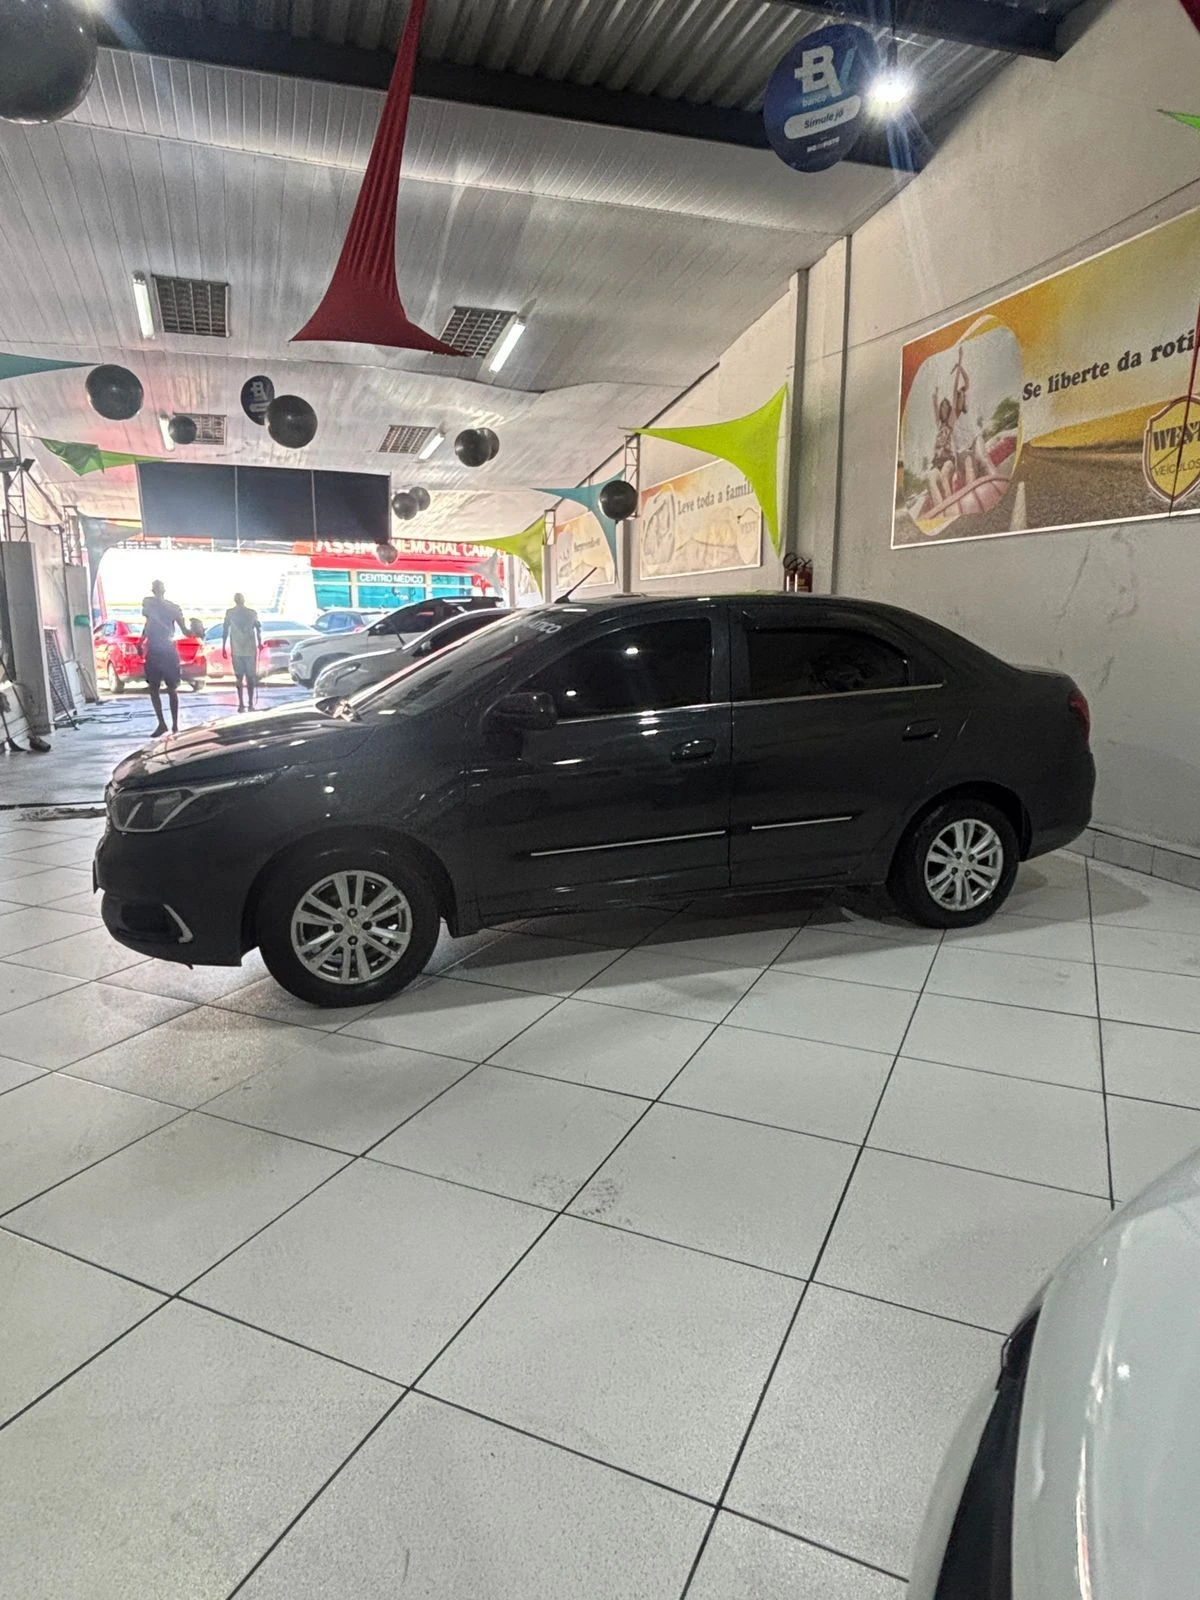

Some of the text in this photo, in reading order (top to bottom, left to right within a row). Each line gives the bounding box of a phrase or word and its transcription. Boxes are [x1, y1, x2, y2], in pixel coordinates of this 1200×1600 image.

[804, 112, 834, 129] Simule
[1022, 382, 1042, 401] Se
[1047, 361, 1110, 394] liberte
[1117, 350, 1142, 372] da
[678, 499, 695, 515] Leve
[697, 491, 715, 509] toda
[717, 491, 723, 504] a
[392, 539, 461, 555] MEMORIAL
[360, 573, 425, 584] CENTRO MÉDICO
